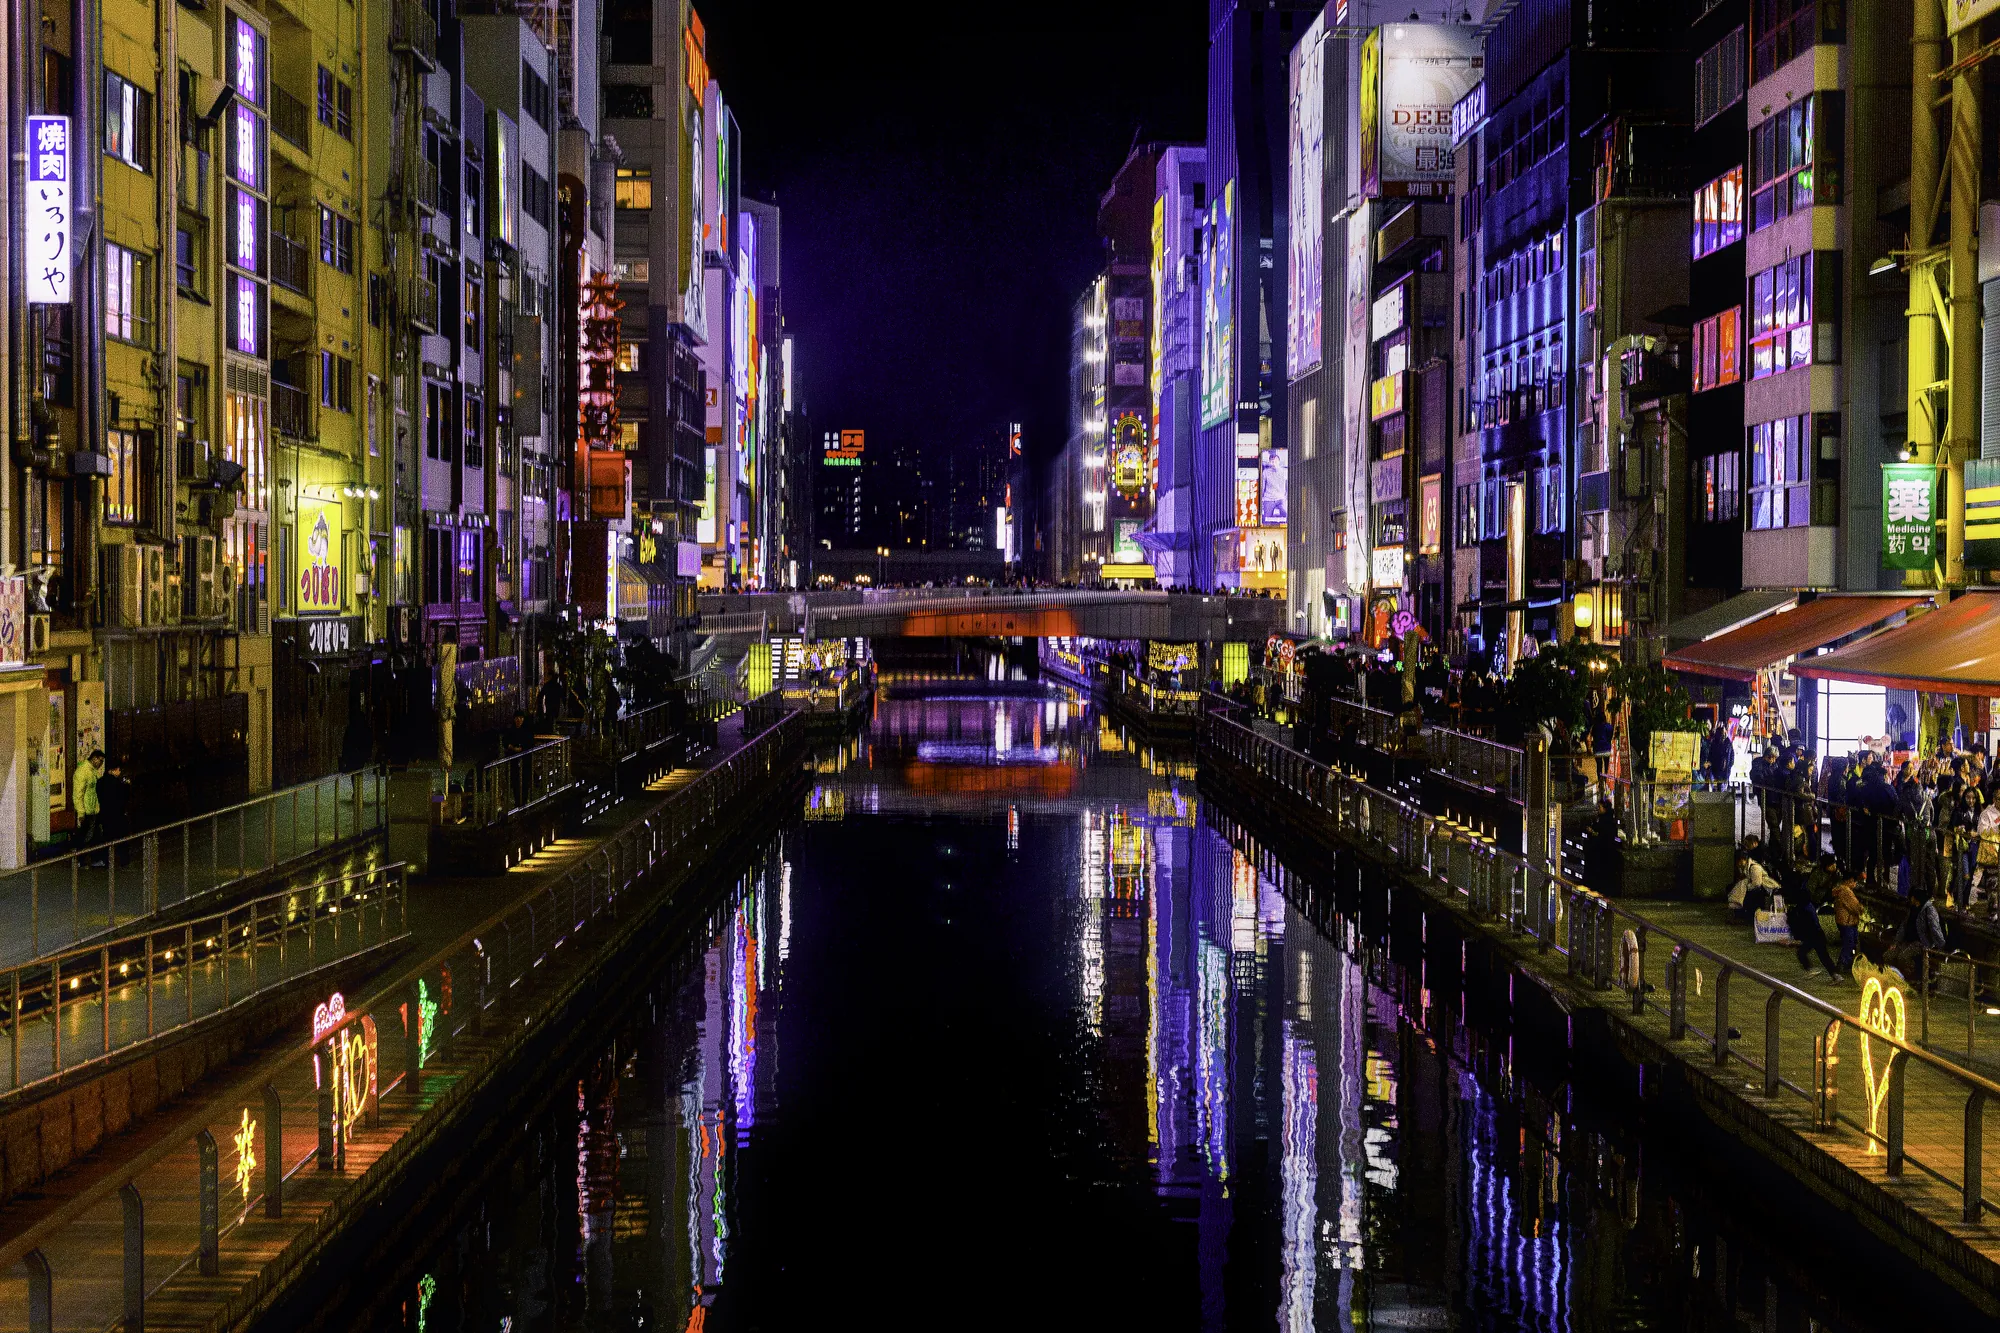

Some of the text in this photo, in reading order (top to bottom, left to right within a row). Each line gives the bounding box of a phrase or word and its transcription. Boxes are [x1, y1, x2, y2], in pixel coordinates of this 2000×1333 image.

[38, 122, 65, 296] 焼肉 いろりや
[1888, 479, 1930, 522] 薬
[1887, 524, 1931, 534] Medicine
[1911, 535, 1931, 555] 약
